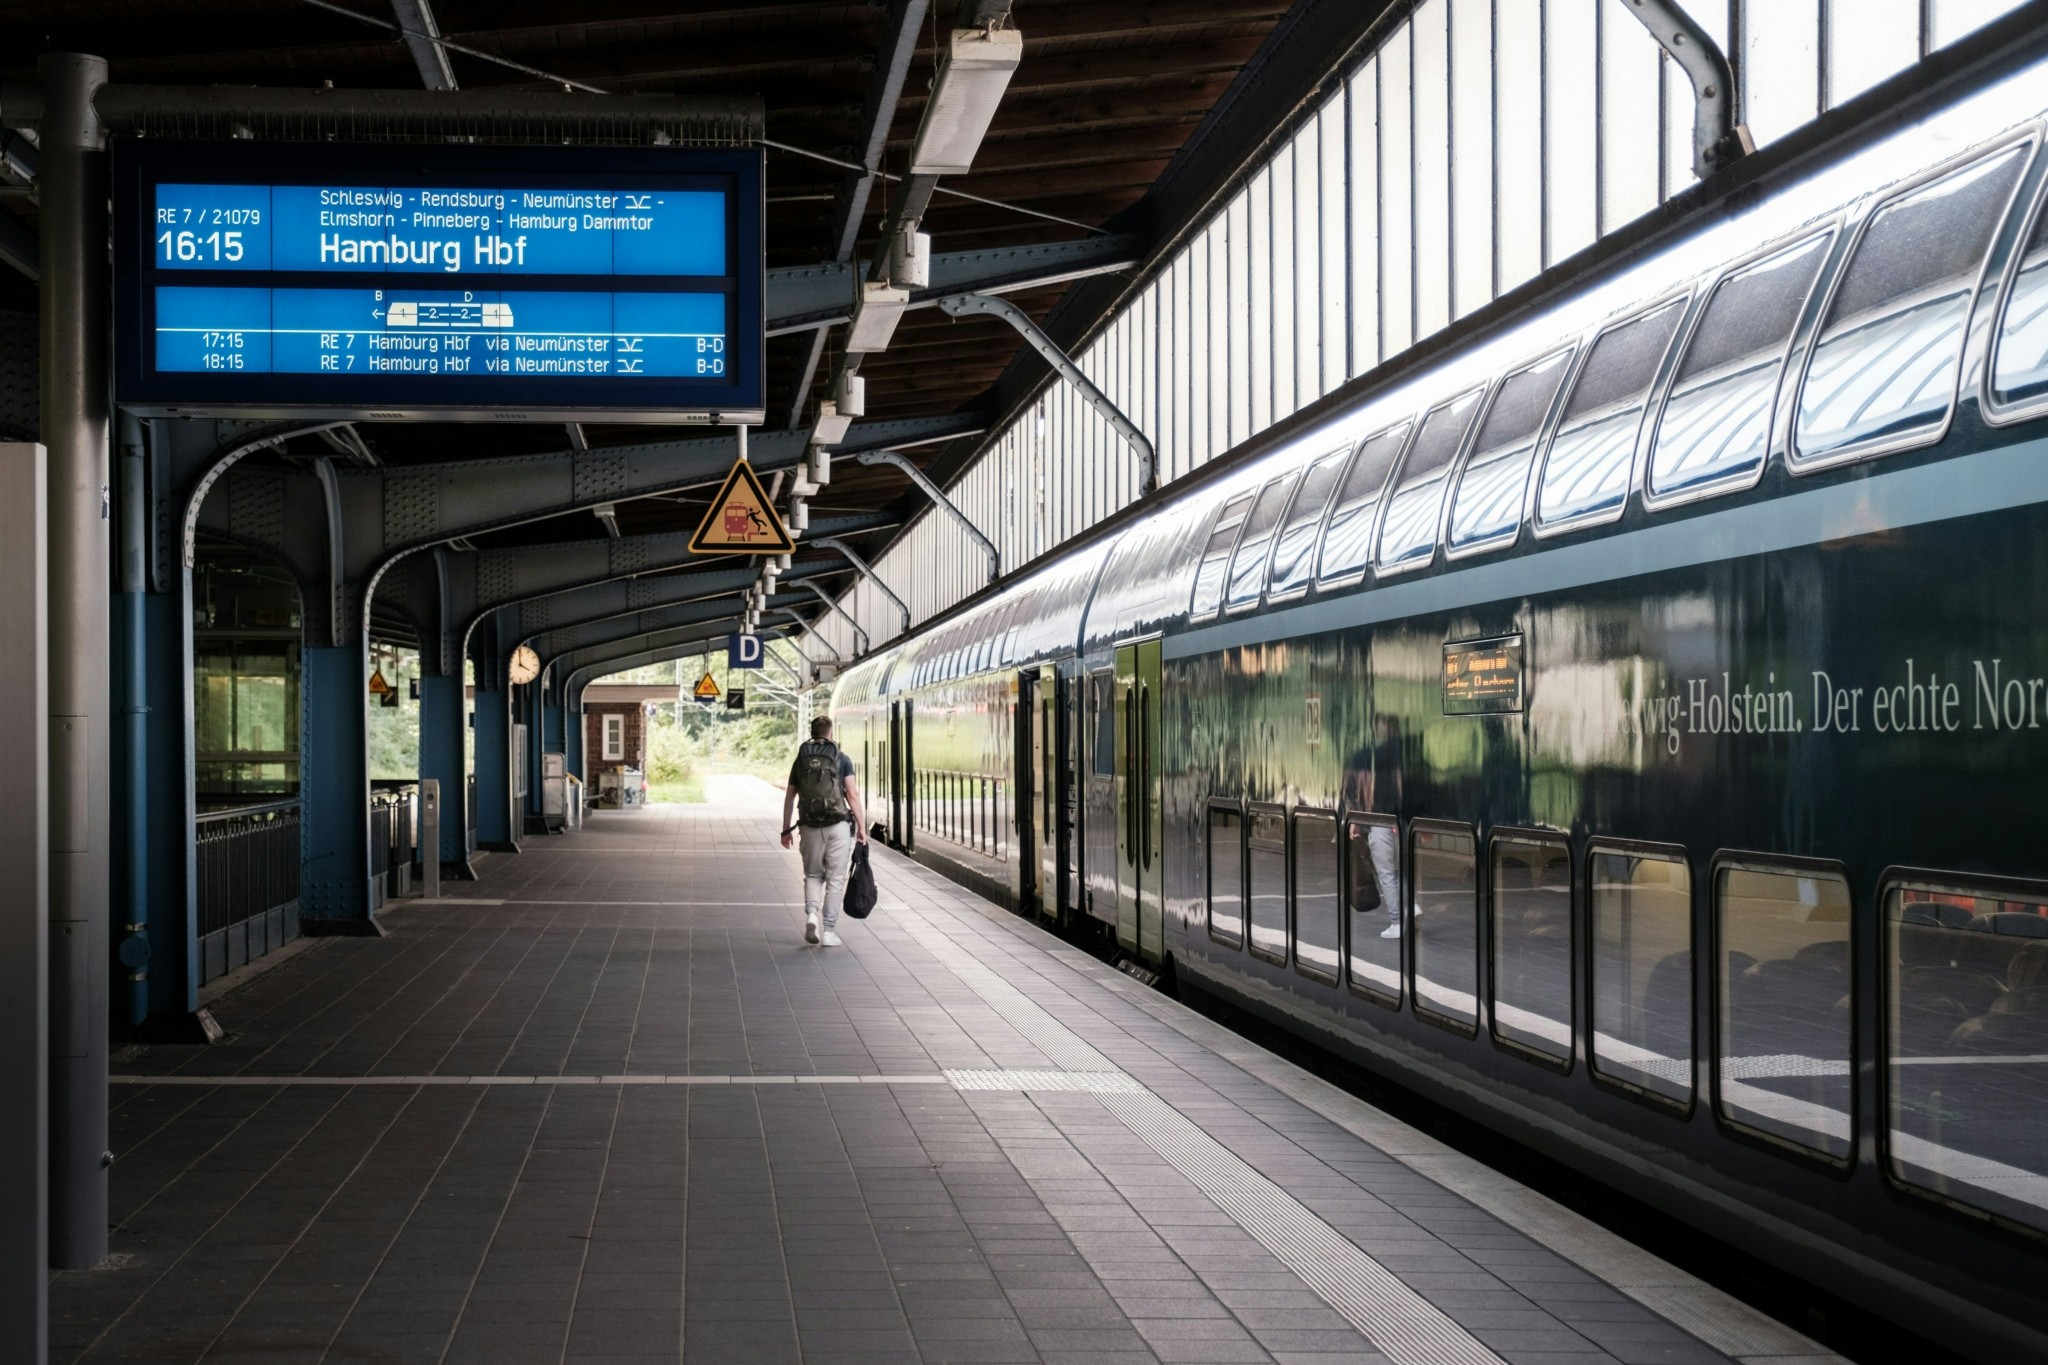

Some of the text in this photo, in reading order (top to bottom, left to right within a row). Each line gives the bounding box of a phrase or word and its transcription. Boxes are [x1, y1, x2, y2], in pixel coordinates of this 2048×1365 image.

[320, 190, 403, 209] Schleswig
[422, 192, 505, 210] Rendsburg
[523, 193, 618, 209] Neumünster
[157, 208, 260, 225] RE 7 / 21079
[320, 211, 395, 227] Elmshorn
[413, 212, 490, 231] Pinneberg
[509, 213, 577, 232] Hamburg
[583, 214, 653, 230] Dammtor
[157, 230, 243, 261] 16:15
[320, 233, 527, 272] Hamburg Hbf
[375, 290, 383, 301] B
[464, 291, 473, 302] D
[202, 333, 724, 353] 17:15 RE 7 Hamburg Hbf via Neumünster B-D
[202, 354, 724, 374] 18:15 RE 7 Hamburg Hbf via Neumünster B-D
[739, 635, 760, 662] D
[1812, 671, 1863, 733] Der
[1873, 658, 1960, 732] echte
[1973, 659, 2048, 731] Nor
[1306, 700, 1320, 741] DB
